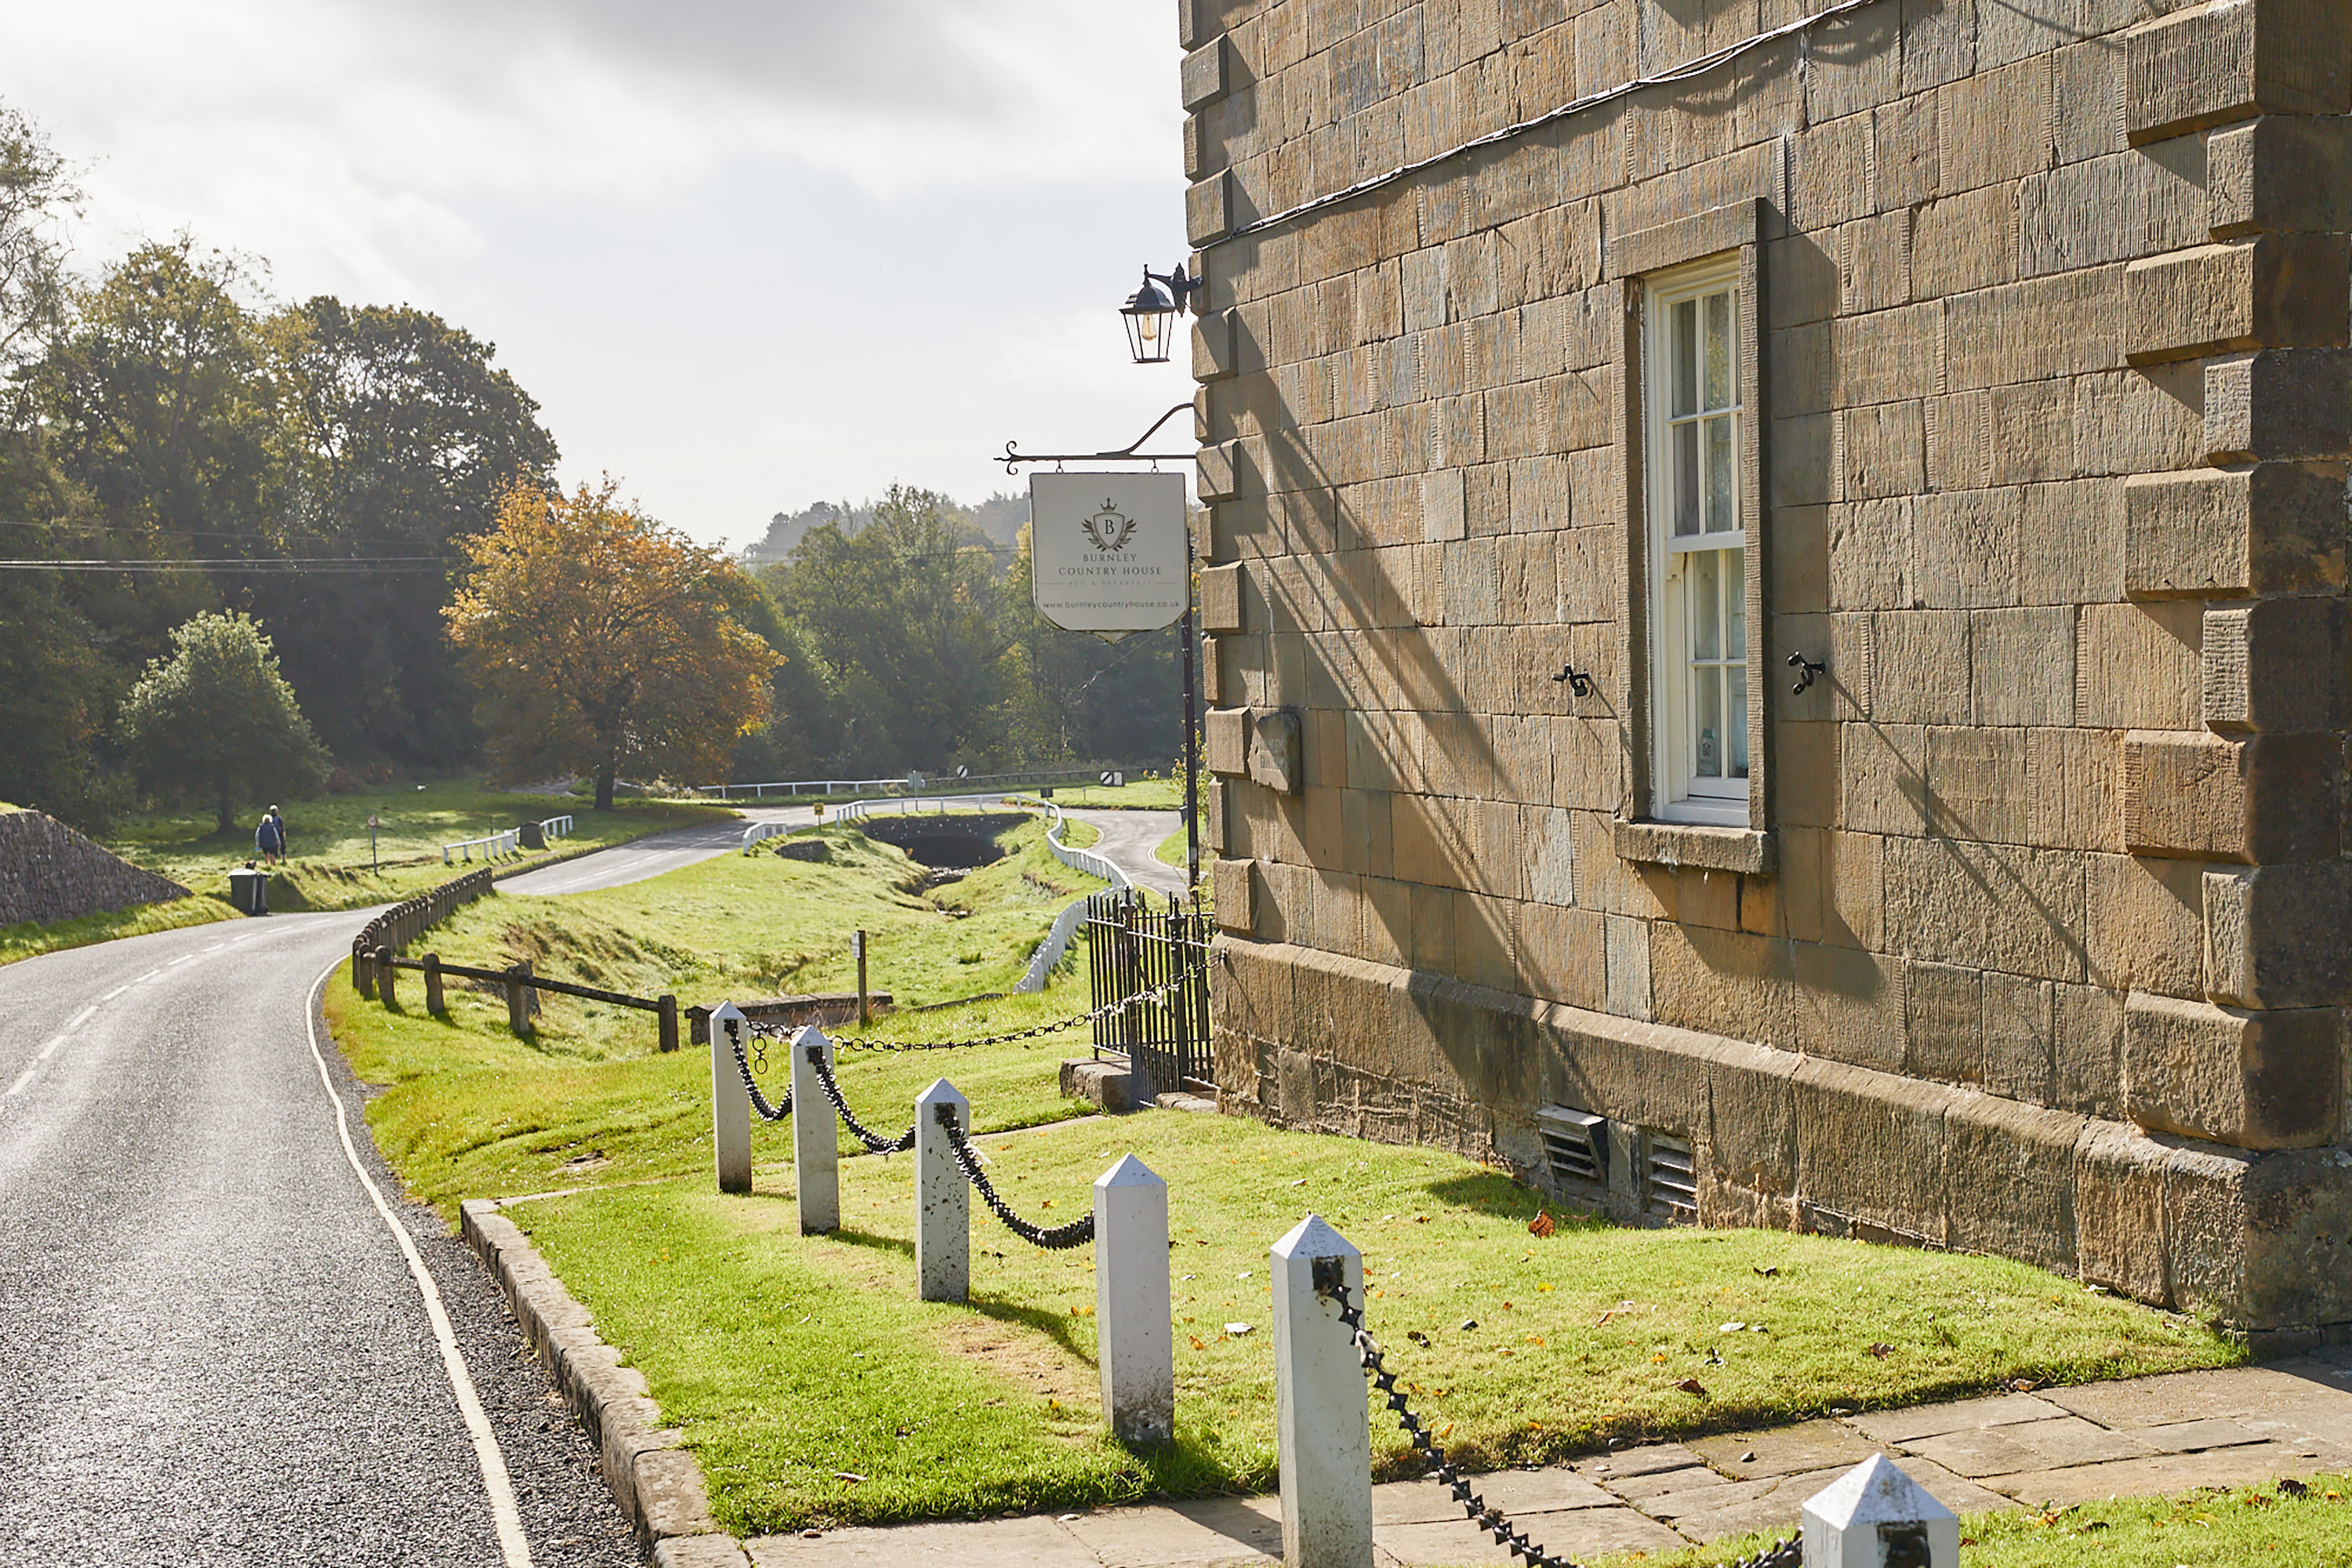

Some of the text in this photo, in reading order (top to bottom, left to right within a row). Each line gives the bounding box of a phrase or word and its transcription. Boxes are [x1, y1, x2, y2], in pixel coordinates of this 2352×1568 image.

[1105, 520, 1115, 535] B
[1083, 554, 1138, 563] BURNLEY
[1058, 566, 1162, 576] COUNTRY HOUSE
[1042, 600, 1180, 609] www.burnleycountryhouse.co.uk
